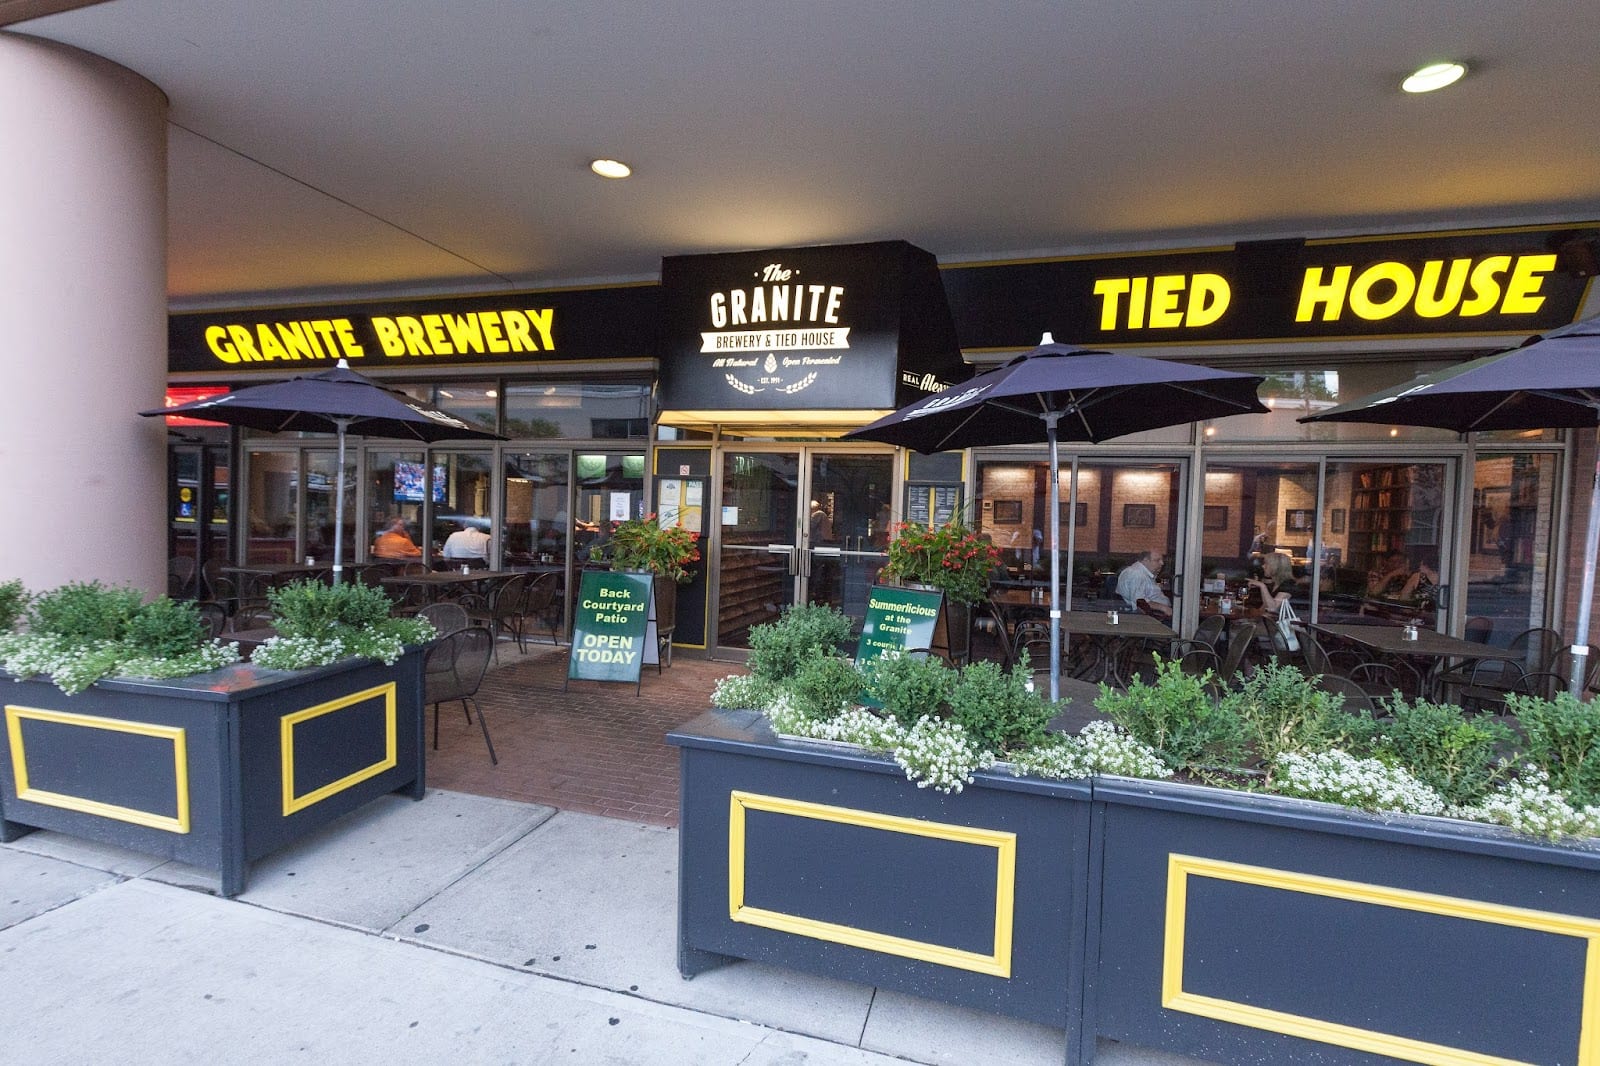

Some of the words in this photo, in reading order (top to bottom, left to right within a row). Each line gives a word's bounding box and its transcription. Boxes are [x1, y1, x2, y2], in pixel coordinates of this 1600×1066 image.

[762, 263, 792, 282] The
[1093, 273, 1231, 331] TIED
[1295, 254, 1557, 322] HOUSE
[710, 284, 844, 328] GRANITE
[204, 317, 365, 364] GRANITE
[371, 308, 555, 357] BREWERY
[716, 334, 761, 349] BREWERY
[765, 334, 771, 347] &
[775, 333, 797, 347] TIED
[801, 332, 835, 346] HOUSE
[712, 358, 726, 367] All
[726, 358, 758, 367] Natural
[782, 356, 801, 367] Open
[802, 356, 842, 365] Fermented
[903, 373, 920, 385] REAL
[600, 588, 631, 599] Back
[582, 600, 645, 612] Courtyard
[869, 598, 937, 617] Summerlicious
[595, 613, 628, 624] Patio
[896, 615, 912, 624] the
[879, 624, 913, 635] Granite
[583, 634, 633, 650] OPEN
[576, 648, 637, 665] TODAY
